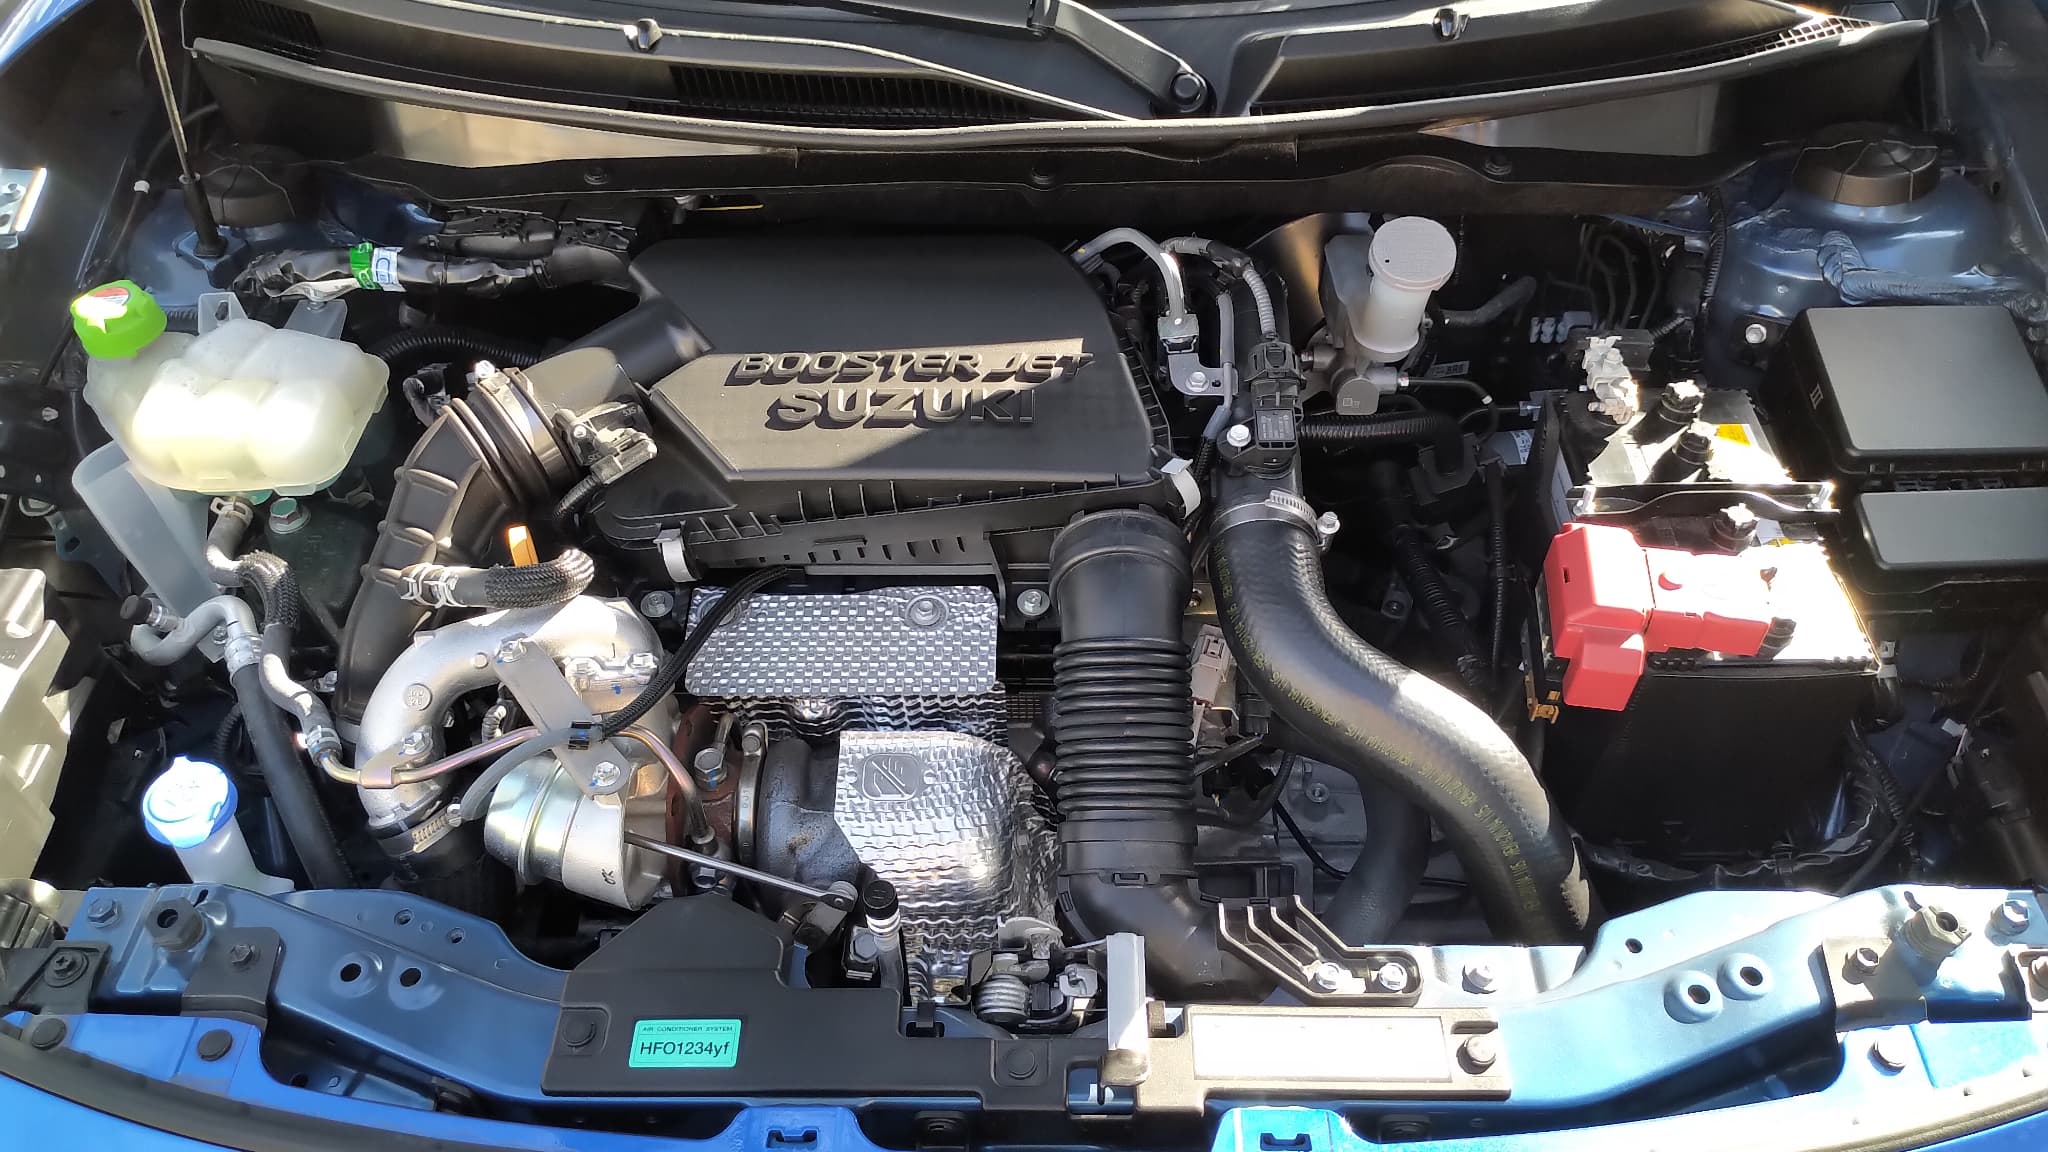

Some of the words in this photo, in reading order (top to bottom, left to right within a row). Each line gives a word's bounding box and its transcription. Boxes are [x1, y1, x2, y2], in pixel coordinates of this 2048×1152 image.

[731, 350, 984, 381] BOOSTER
[986, 351, 1095, 381] JET
[773, 387, 1036, 426] SUZUKI
[640, 1041, 731, 1058] HFO1234yf
